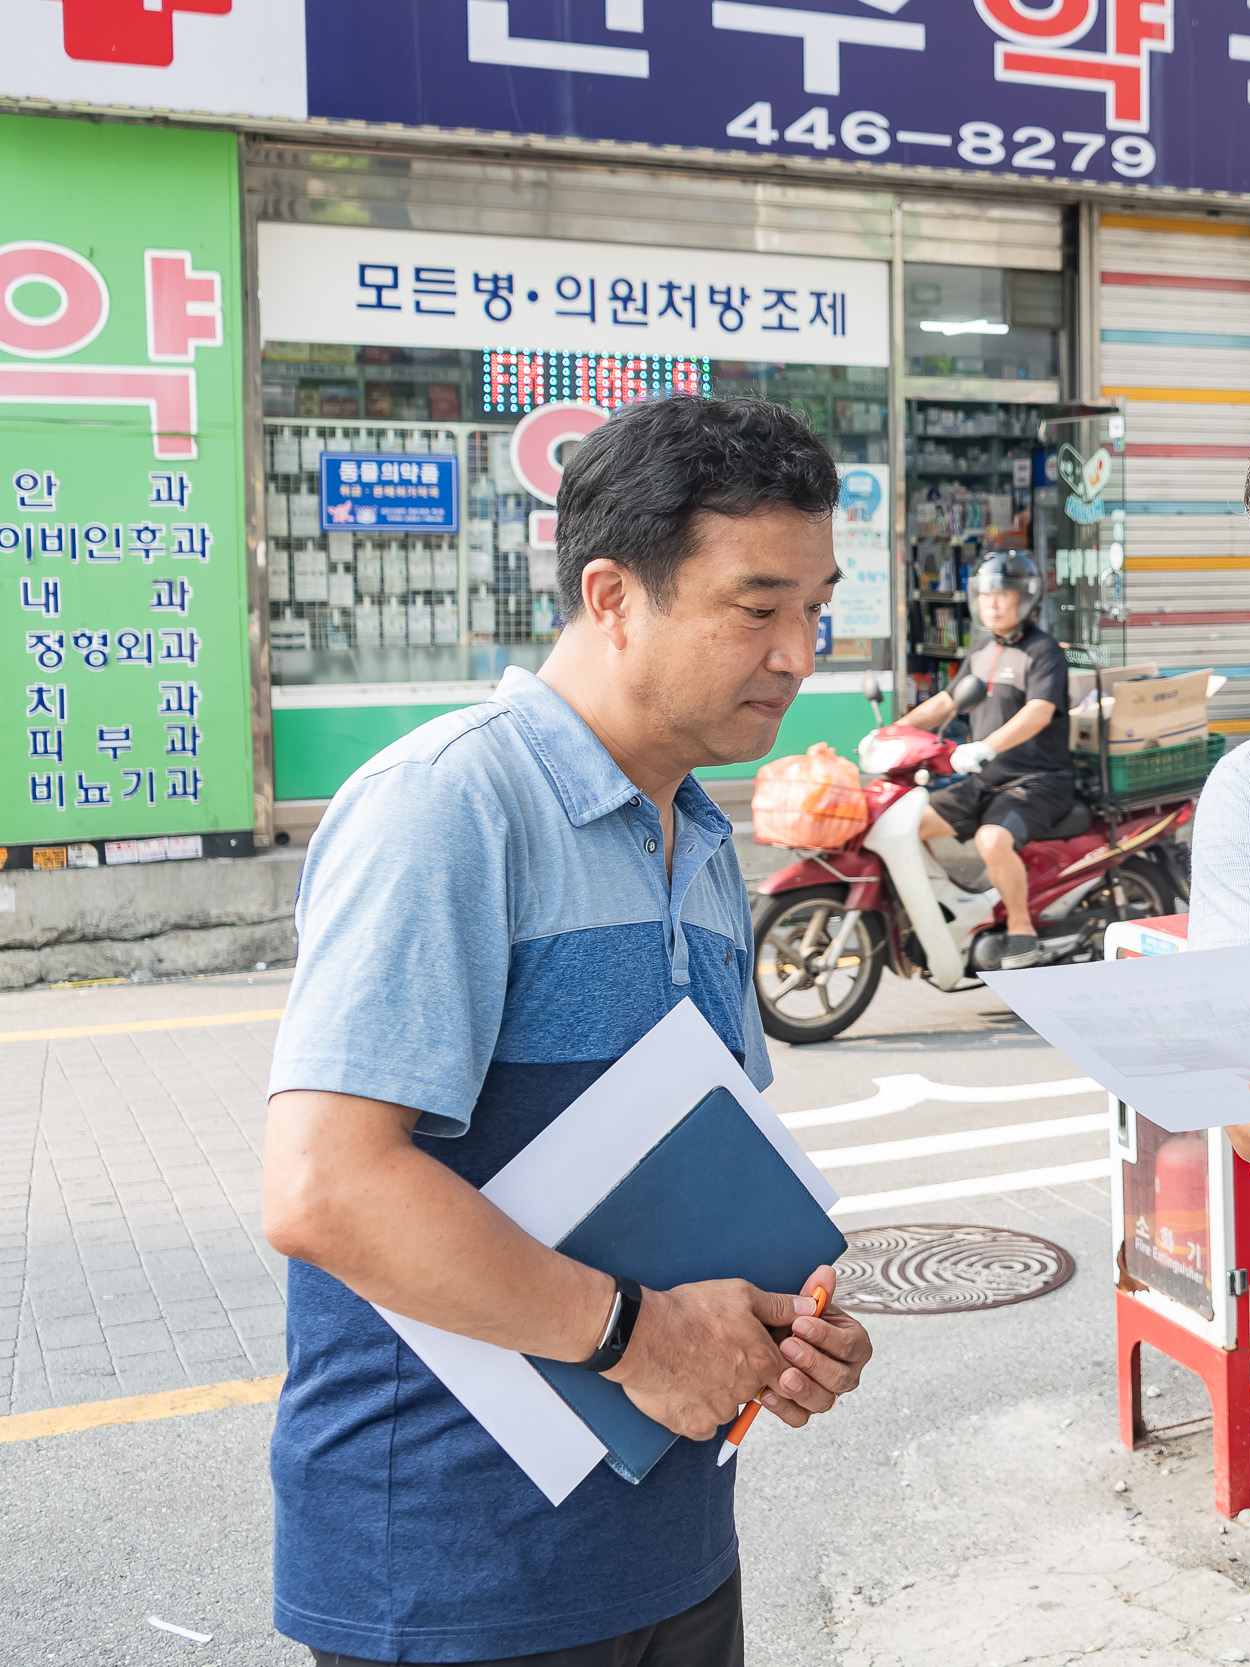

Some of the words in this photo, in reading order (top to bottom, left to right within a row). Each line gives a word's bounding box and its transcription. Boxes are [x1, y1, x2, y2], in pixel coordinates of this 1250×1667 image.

[726, 101, 1157, 178] 446-8279
[0, 240, 223, 460] 약
[13, 470, 60, 511] 안
[148, 471, 192, 511] 과
[339, 461, 439, 484] 동물의약품
[0, 521, 213, 563] 이비인후과
[20, 577, 61, 618] 내
[149, 576, 193, 616] 과
[26, 628, 202, 672] 정형외과
[26, 682, 68, 723] 치
[158, 681, 202, 719] 과
[29, 768, 203, 811] 비뇨기과
[1134, 1236, 1151, 1257] Fire
[1152, 1245, 1205, 1285] Extinguisher
